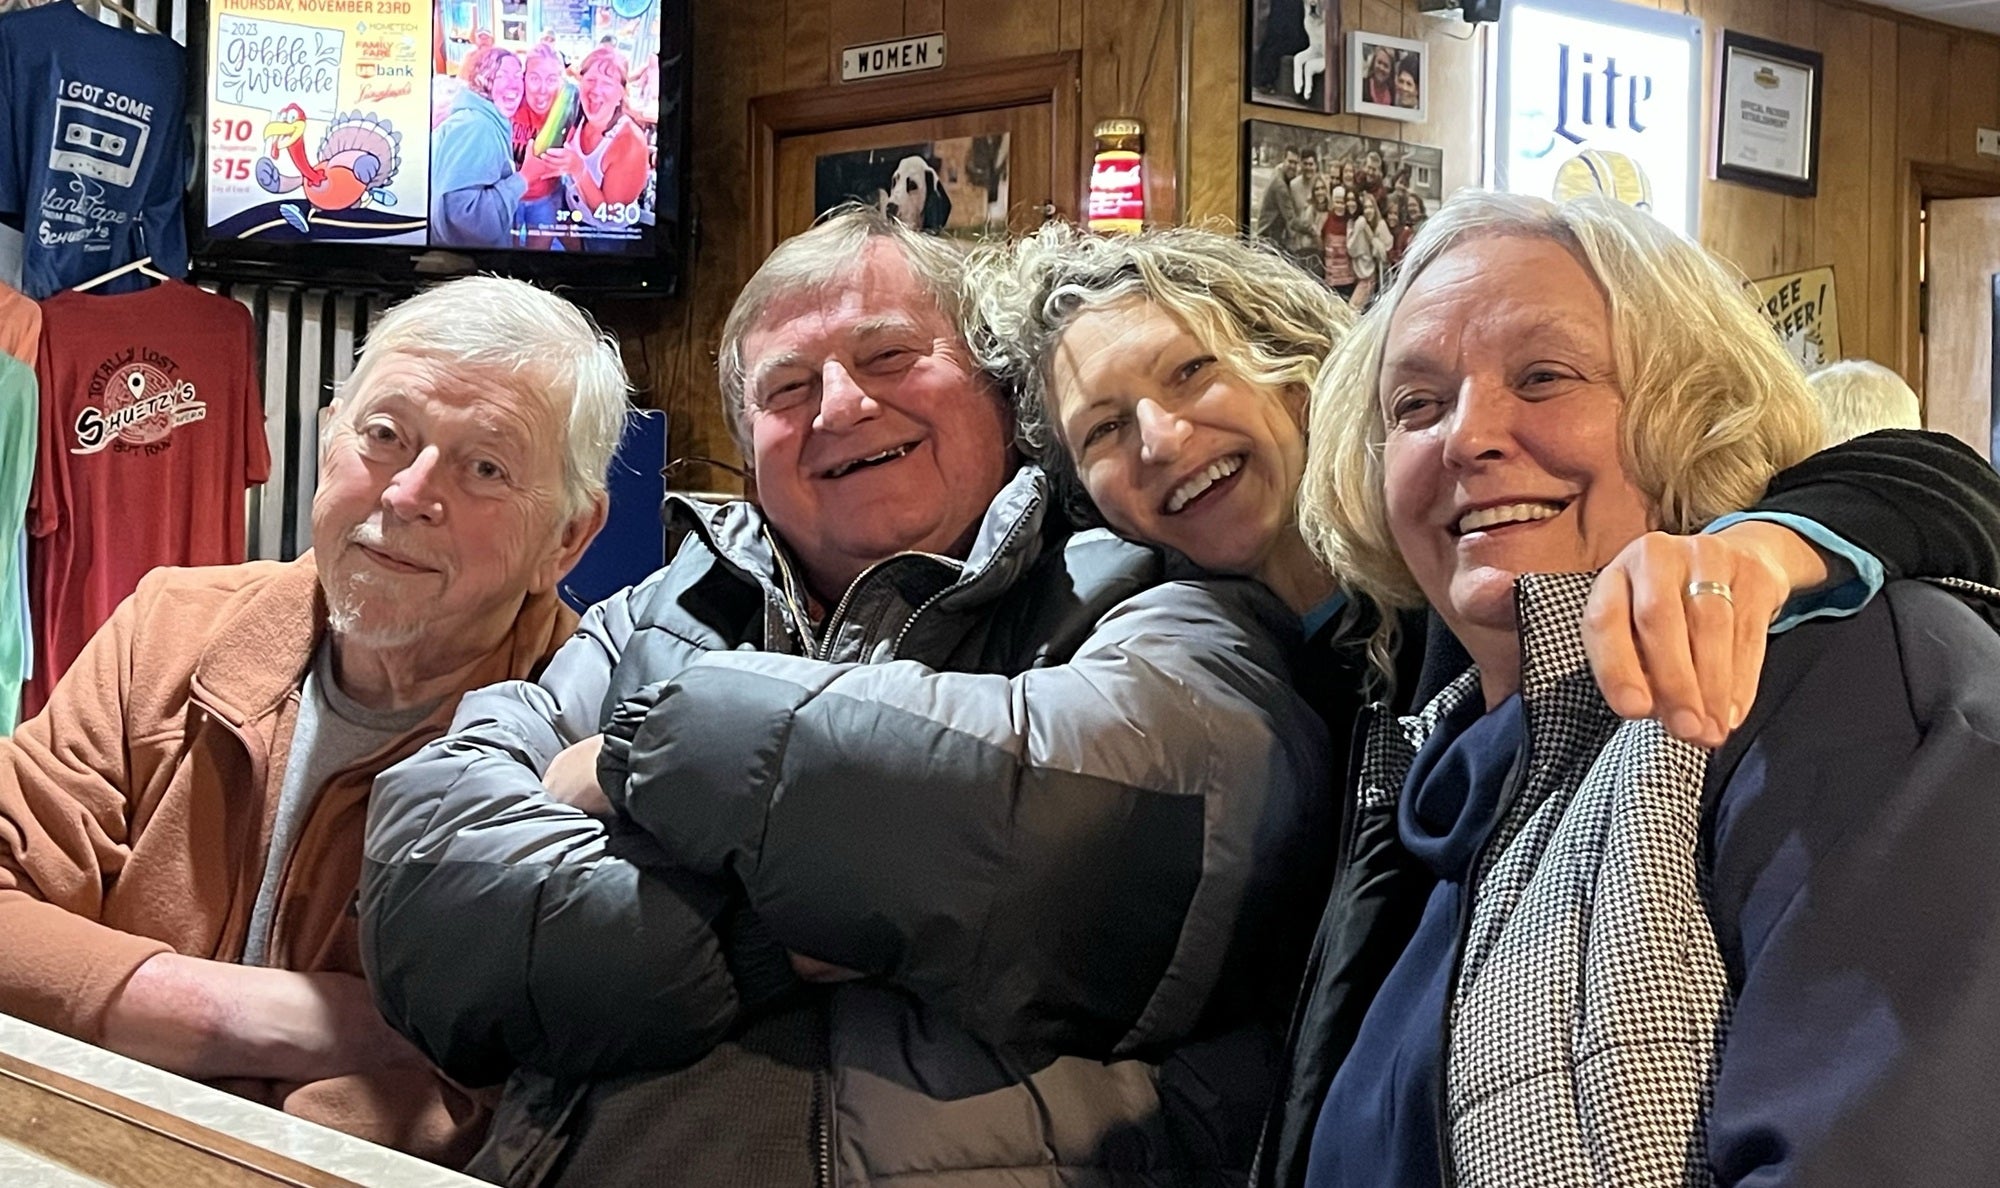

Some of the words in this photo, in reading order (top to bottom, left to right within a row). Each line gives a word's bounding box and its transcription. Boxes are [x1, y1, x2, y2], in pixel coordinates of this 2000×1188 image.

[223, 0, 294, 12] THURSDAY,
[298, 0, 373, 14] NOVEMBER
[377, 1, 411, 15] 23RD
[231, 22, 258, 36] 2023
[858, 42, 928, 73] WOMEN
[376, 64, 414, 77] bank
[58, 79, 65, 95] I
[67, 81, 104, 103] GOT
[104, 91, 153, 121] SOME
[1552, 42, 1653, 145] Lite
[212, 118, 252, 141] $10
[212, 158, 251, 180] $15
[593, 202, 641, 224] 4:30
[1758, 277, 1802, 318] REE
[88, 347, 135, 399] TOTALLY
[142, 346, 180, 375] LOST
